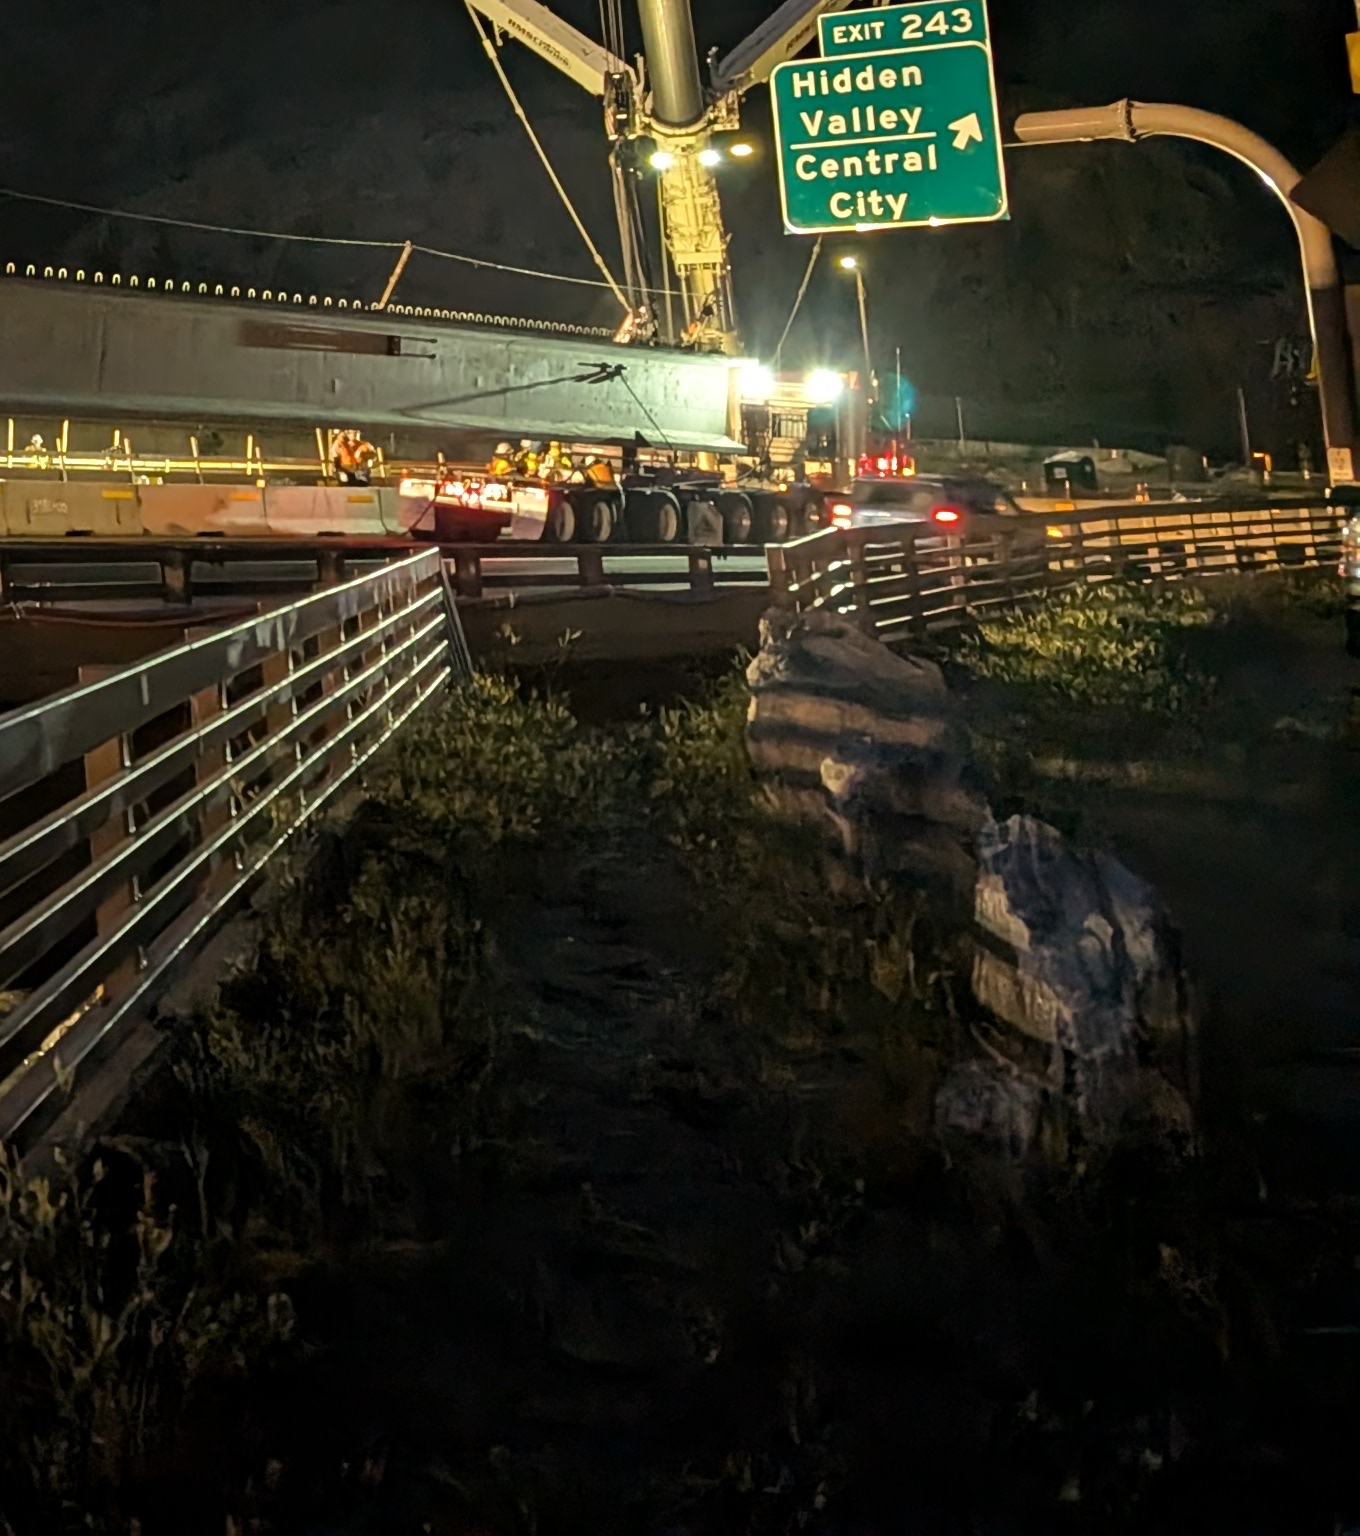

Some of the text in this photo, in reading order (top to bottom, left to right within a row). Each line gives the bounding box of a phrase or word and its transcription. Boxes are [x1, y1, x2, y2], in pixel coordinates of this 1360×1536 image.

[833, 22, 885, 44] EXIT
[901, 8, 973, 39] 243
[792, 64, 922, 98] Hidden
[800, 105, 922, 137] Valley
[795, 144, 938, 180] Central
[830, 190, 908, 220] City
